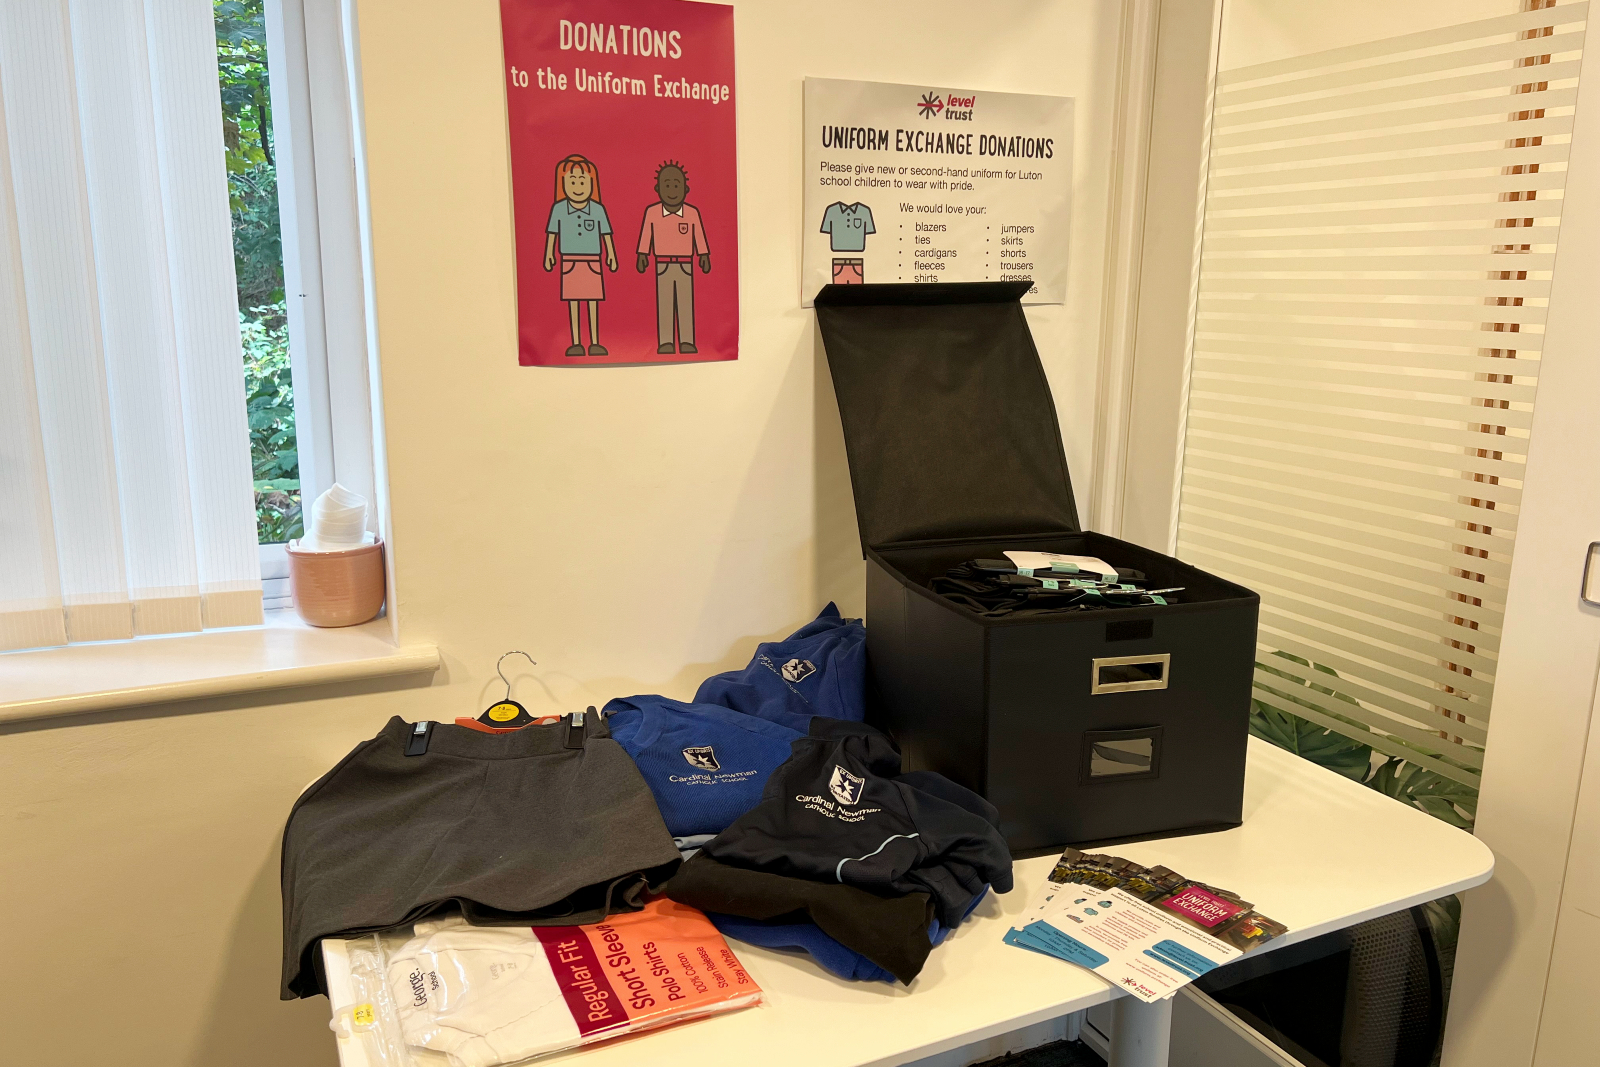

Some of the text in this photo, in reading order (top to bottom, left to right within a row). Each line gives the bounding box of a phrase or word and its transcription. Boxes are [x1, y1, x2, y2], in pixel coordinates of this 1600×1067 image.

[560, 20, 682, 59] DONATIONS
[511, 66, 730, 104] to the Uniform Exchange
[946, 94, 975, 108] level
[945, 108, 973, 121] trust
[822, 125, 1054, 159] UNIFORM EXCHANGE DONATIONS
[820, 161, 1042, 180] Please give new or second-hand uniform for Luton
[820, 176, 852, 187] school
[854, 177, 891, 188] children
[894, 179, 903, 188] to
[929, 179, 948, 190] with
[950, 181, 975, 191] pride.
[899, 203, 987, 216] We would love your:
[915, 222, 947, 232] blazers
[1001, 224, 1034, 235] jumpers
[915, 235, 931, 245] ties
[1001, 236, 1023, 245] skirts
[914, 248, 957, 259] cardigans
[1000, 248, 1026, 257] shorts
[914, 260, 945, 270] fleeces
[1000, 262, 1034, 270] trousers
[914, 273, 938, 283] shirts
[1000, 273, 1032, 282] dresses
[669, 770, 757, 782] Cardinal Newman
[796, 795, 881, 817] Cardinal Newman
[805, 804, 836, 818] CATHOLIC
[1172, 898, 1219, 921] EXCHANGE
[1182, 893, 1228, 917] UNIFORM
[596, 925, 655, 1010] Short Sleeve
[643, 942, 686, 1001] Polo Shirts
[677, 952, 708, 993] 100% Cotton
[697, 946, 728, 988] Stain Release
[721, 949, 748, 984] Stay White
[558, 940, 612, 1022] Regular Fit
[1134, 987, 1152, 998] trust
[1139, 984, 1157, 996] level
